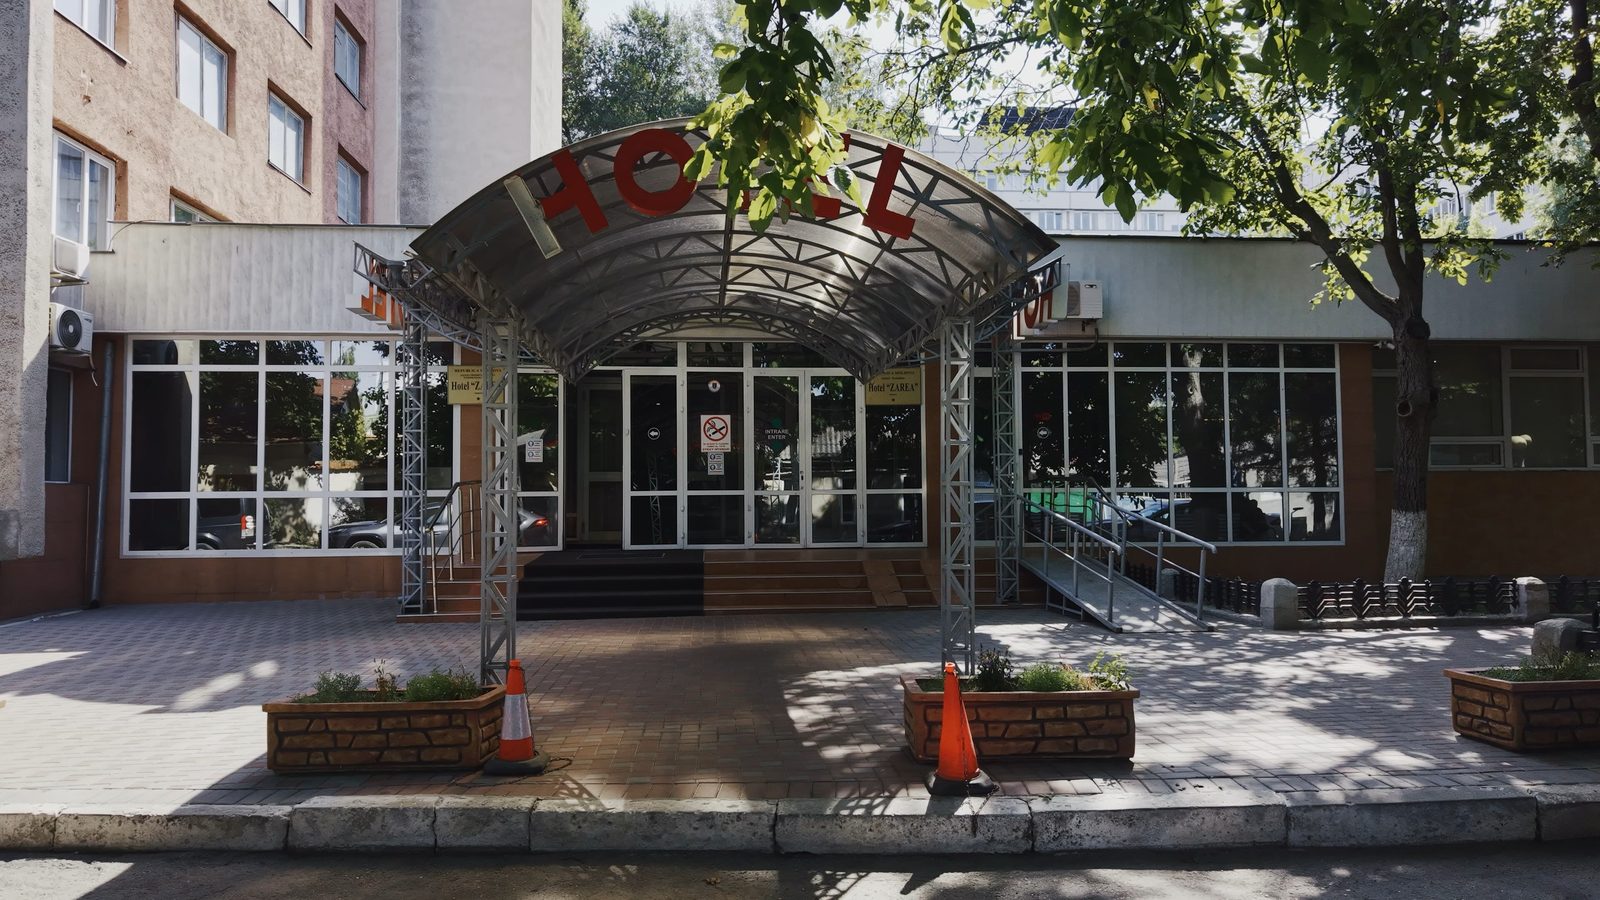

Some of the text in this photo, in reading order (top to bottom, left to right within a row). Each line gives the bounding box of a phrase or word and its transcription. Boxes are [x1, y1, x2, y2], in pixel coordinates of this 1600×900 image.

[503, 127, 916, 260] HOL
[451, 382, 470, 390] Hotel
[868, 382, 885, 392] Hotel
